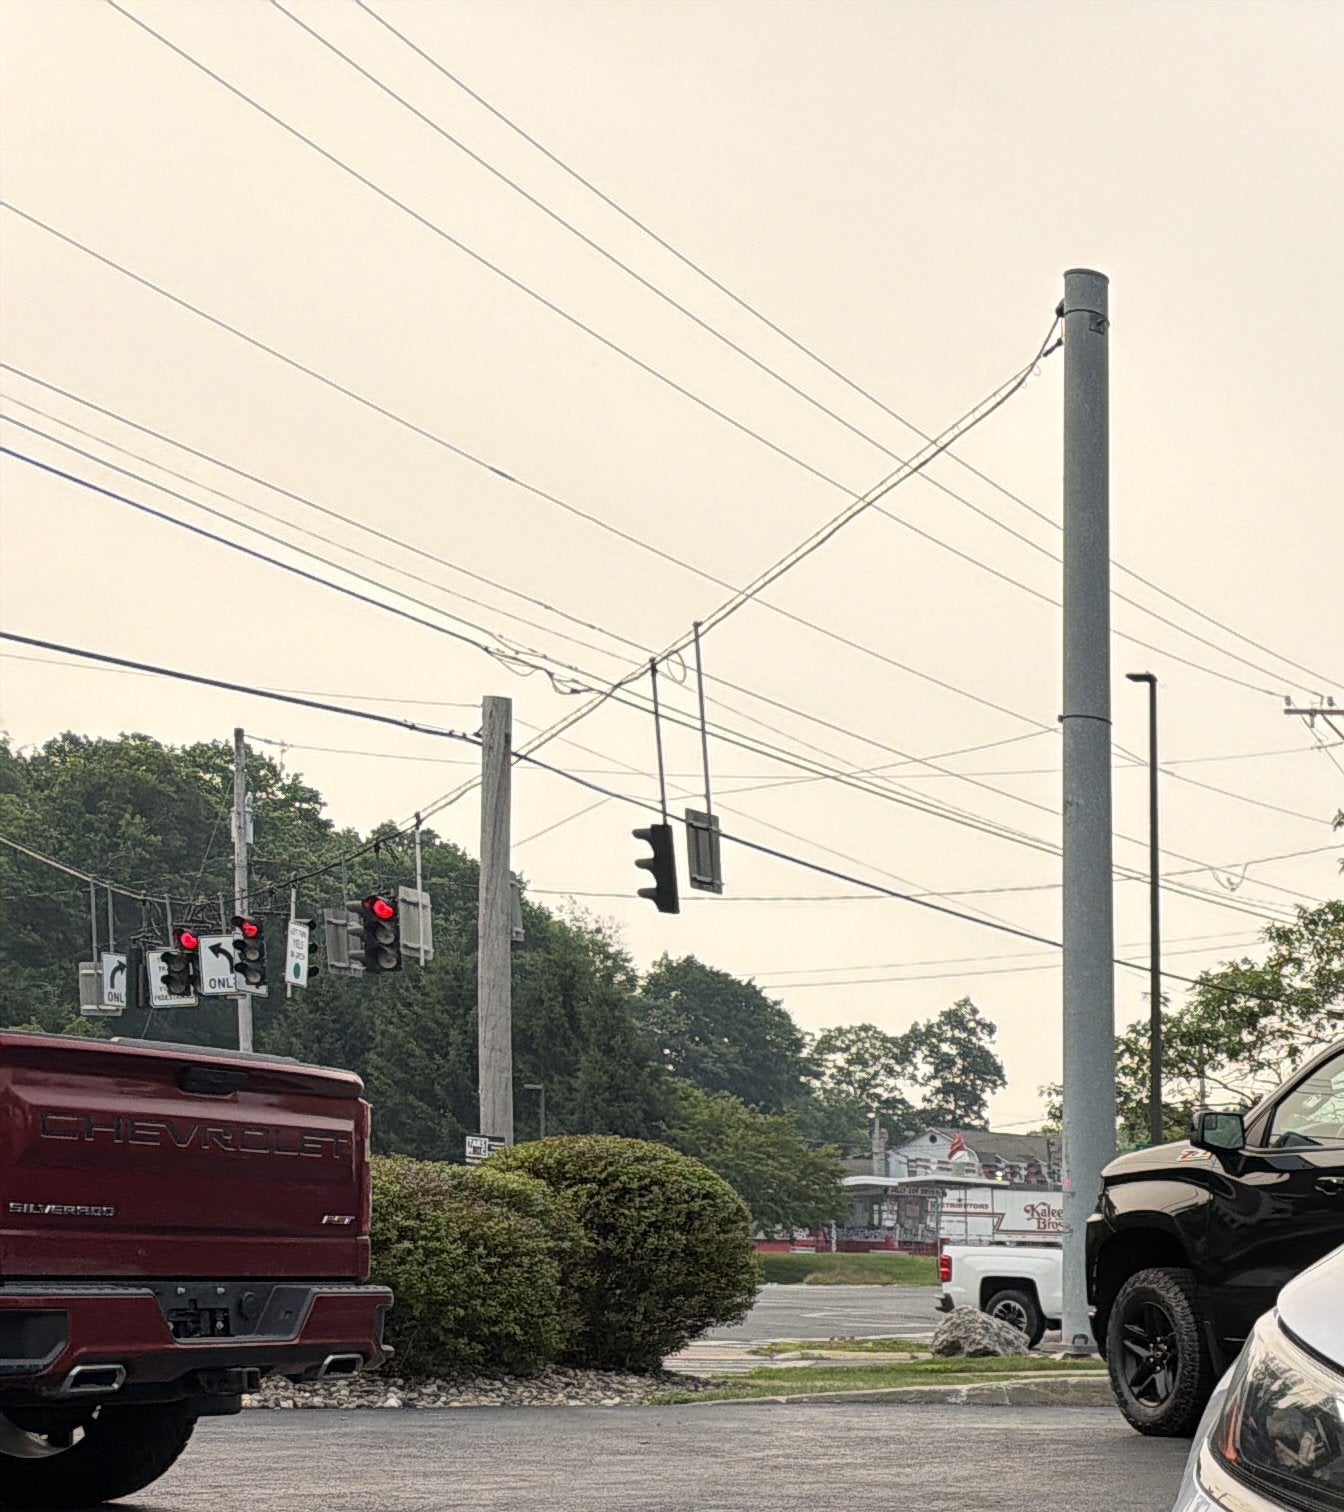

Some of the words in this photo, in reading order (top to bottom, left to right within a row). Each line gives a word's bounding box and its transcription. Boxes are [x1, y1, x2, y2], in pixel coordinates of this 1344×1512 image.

[107, 991, 126, 1004] ONL
[41, 1113, 350, 1160] CHEVROLET
[8, 1202, 116, 1217] SILVERADO
